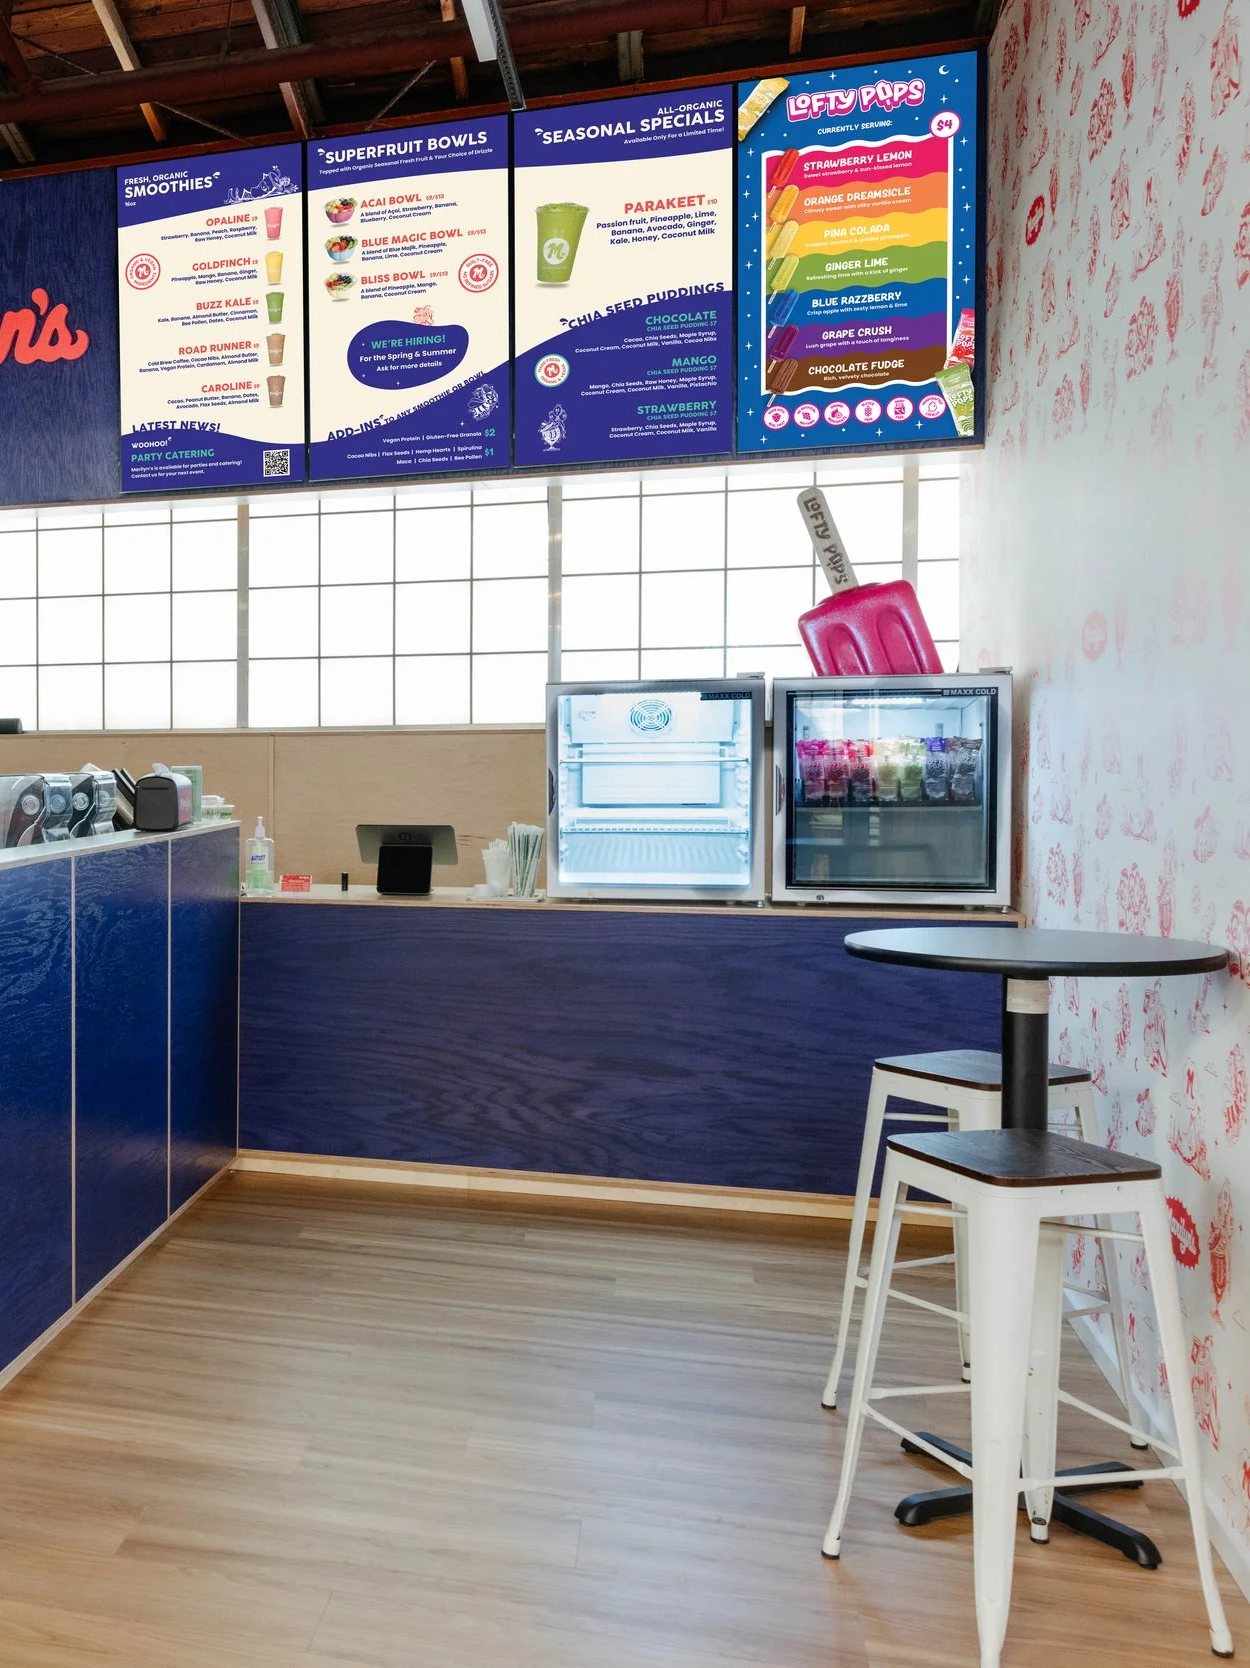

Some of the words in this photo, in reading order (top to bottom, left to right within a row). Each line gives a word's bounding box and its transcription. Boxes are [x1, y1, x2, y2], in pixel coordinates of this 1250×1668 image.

[657, 99, 722, 115] ALL-ORGANIC
[786, 88, 856, 122] LOFTY
[858, 78, 926, 112] POPS
[542, 121, 635, 144] SEASONAL
[640, 109, 724, 132] SPECIALS
[817, 123, 859, 135] CURRENTLY
[860, 119, 892, 129] SERVING:
[936, 119, 952, 131] $4
[325, 139, 423, 164] SUPERFRUIT
[427, 131, 487, 150] BOWLS
[623, 136, 652, 144] Available
[803, 154, 874, 171] STRAWBERRY
[876, 150, 912, 162] LEMON
[319, 167, 339, 175] Topped
[351, 163, 373, 171] Organic
[124, 175, 151, 185] FRESH,
[152, 170, 188, 181] ORGANIC
[124, 176, 212, 198] SMOOTHIES
[360, 197, 386, 208] ACAI
[389, 193, 422, 205] BOWL
[803, 193, 844, 206] ORANGE
[846, 186, 910, 202] DREAMSICLE
[624, 194, 705, 214] PARAKEET
[205, 213, 250, 226] OPALINE
[596, 220, 628, 229] Passion
[629, 217, 648, 225] fruit,
[650, 212, 693, 223] Pineapple,
[694, 210, 717, 218] Lime,
[611, 227, 645, 236] Banana,
[646, 222, 685, 232] Avocado,
[686, 219, 717, 228] Ginger,
[823, 227, 847, 238] PINA
[849, 223, 890, 236] COLADA
[361, 236, 389, 247] BLUE
[391, 232, 426, 244] MAGIC
[429, 228, 463, 240] BOWL
[610, 237, 630, 245] Kale,
[631, 234, 660, 242] Honey,
[661, 229, 696, 239] Coconut
[697, 227, 715, 235] Milk
[192, 257, 250, 271] GOLDFINCH
[825, 260, 861, 271] GINGER
[864, 257, 888, 267] LIME
[361, 273, 390, 285] BLISS
[393, 270, 425, 281] BOWL
[196, 300, 222, 310] BUZZ
[225, 297, 251, 307] KALE
[568, 310, 602, 328] CHIA
[605, 298, 643, 316] SEED
[647, 282, 724, 305] PUDDINGS
[811, 297, 838, 308] BLUE
[840, 291, 901, 305] RAZZBERRY
[645, 310, 717, 325] CHOCOLATE
[821, 328, 855, 340] GRAPE
[857, 325, 892, 337] CRUSH
[178, 345, 207, 355] ROAD
[209, 340, 251, 352] RUNNER
[371, 338, 403, 349] WE'RE
[405, 334, 445, 346] HIRING!
[387, 351, 413, 361] Spring
[422, 348, 456, 356] Summer
[672, 355, 717, 367] MANGO
[418, 360, 442, 368] details
[680, 365, 708, 373] PUDDING
[808, 362, 868, 375] CHOCOLATE
[871, 359, 904, 370] FUDGE
[201, 381, 252, 393] CAROLINE
[328, 416, 381, 441] ADD-INS
[384, 416, 395, 424] TO
[397, 409, 412, 420] ANY
[413, 390, 451, 412] SMOOTHIE
[452, 382, 463, 392] OR
[463, 371, 486, 386] BOWL
[637, 400, 716, 414] STRAWBERRY
[132, 421, 177, 432] LATEST
[182, 421, 221, 432] NEWS!
[484, 428, 495, 437] $2
[131, 439, 167, 448] WOOHOO!
[131, 452, 163, 462] PARTY
[165, 448, 214, 460] CATERING
[484, 448, 493, 456] $1
[804, 497, 830, 540] LOFTY
[823, 544, 848, 584] POPS
